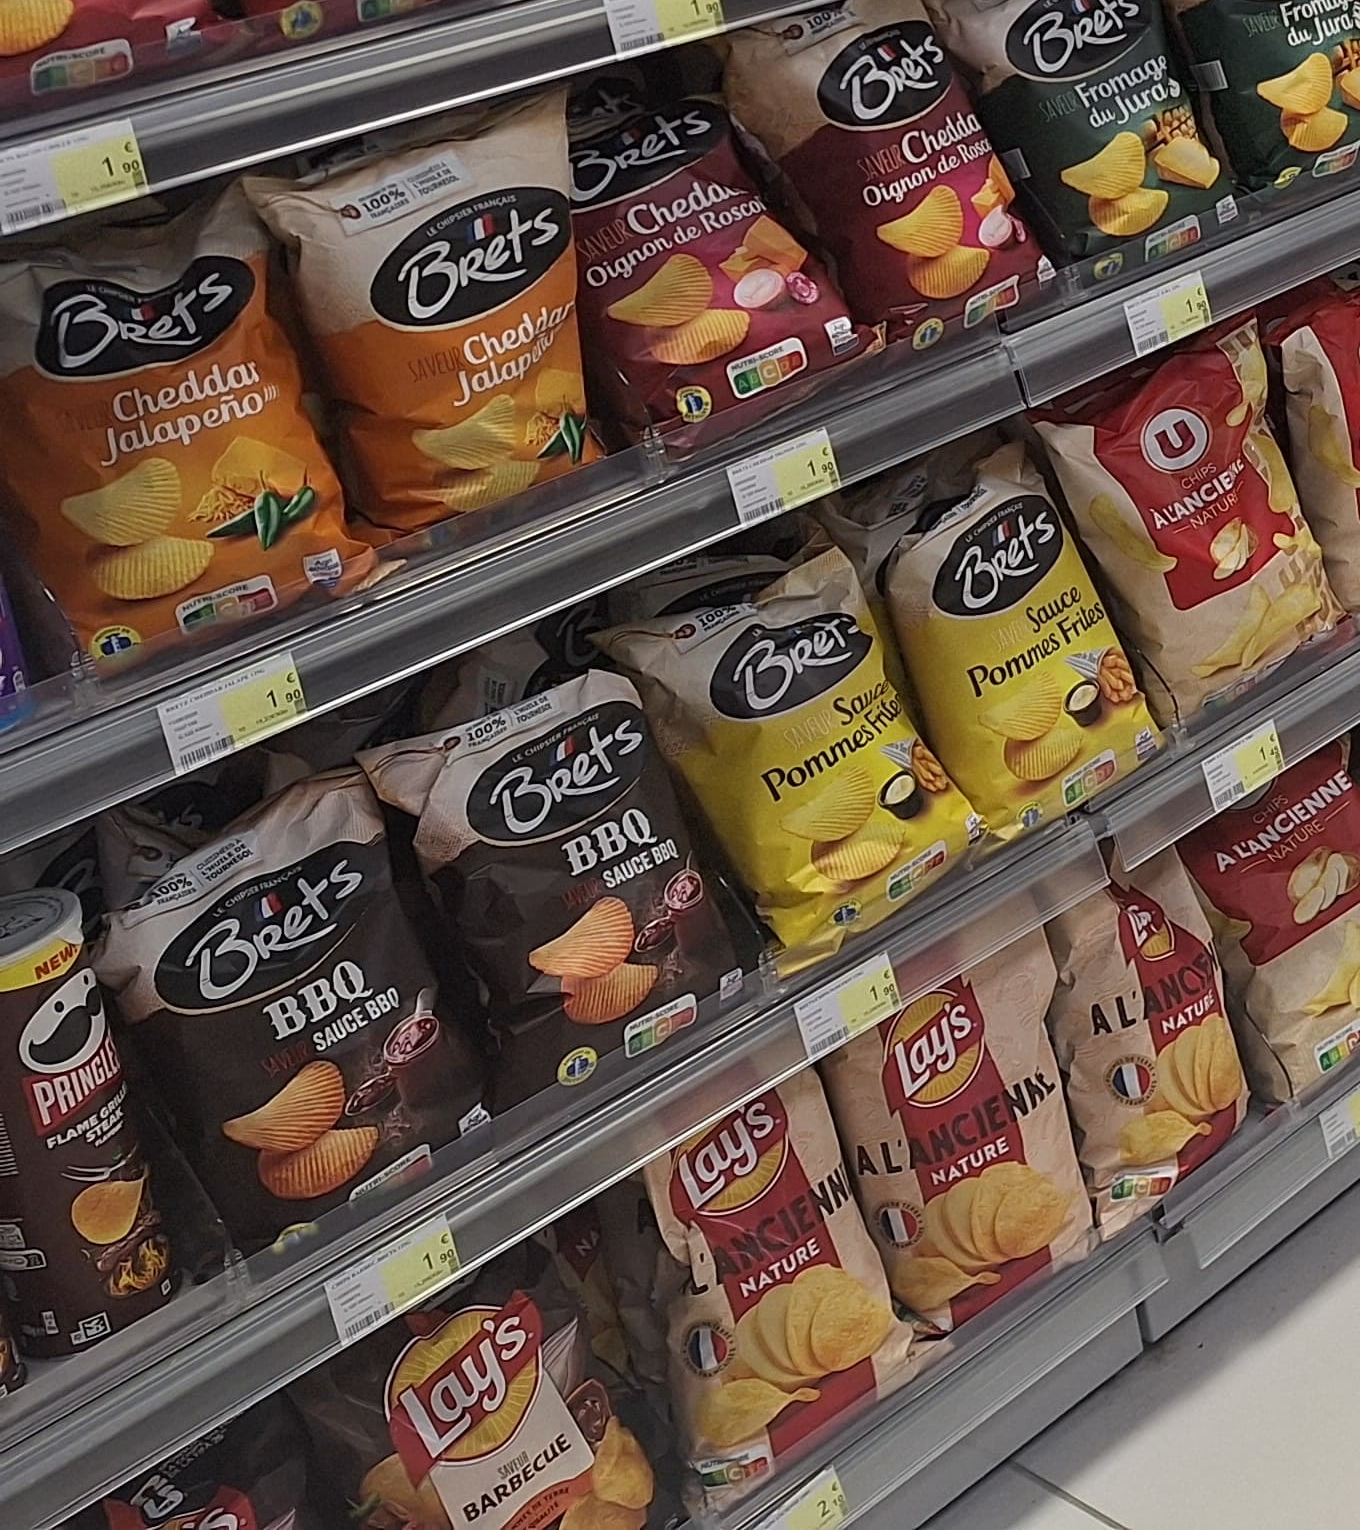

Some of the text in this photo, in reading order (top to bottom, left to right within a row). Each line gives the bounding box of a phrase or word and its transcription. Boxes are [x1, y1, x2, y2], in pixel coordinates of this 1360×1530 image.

[804, 8, 845, 31] 100%
[1243, 12, 1280, 37] SAVEUR
[1287, 11, 1353, 46] du Jura
[840, 32, 945, 122] Brets
[1039, 53, 1169, 123] SAVEUR Fromage
[1088, 87, 1165, 128] du Jura
[102, 156, 114, 177] 1
[122, 159, 140, 173] 90
[361, 187, 406, 213] 100%
[426, 194, 517, 237] LE CHIPSIER FRANÇAIS
[401, 200, 560, 320] Brets
[586, 197, 768, 289] Oignon de Rosco
[51, 270, 234, 369] Brets
[407, 299, 576, 384] SAVEUR Cheddar
[730, 344, 785, 372] NUTRI-SCORE
[111, 359, 261, 422] Cheddar
[100, 392, 265, 467] Jalapeño
[1180, 462, 1218, 491] CHIPS
[954, 505, 1055, 610] Brets
[966, 602, 1105, 699] Pommes Frites
[832, 676, 891, 726] Sauce
[466, 716, 507, 742] 100%
[511, 712, 599, 763] LE CHIPSIER FRANÇAIS
[489, 717, 645, 835] Brets
[1252, 794, 1290, 826] CHIPS
[201, 844, 247, 876] L'HUILE DE
[205, 849, 254, 882] TOURNESOL
[561, 806, 658, 877] BBQ
[602, 858, 652, 890] SAUCE
[651, 839, 680, 868] BBQ
[1266, 819, 1326, 866] NATURE
[212, 867, 302, 918] LE CHIPSIER FRANÇAIS
[185, 860, 364, 1001] Brets
[33, 943, 79, 981] NEW!
[262, 960, 374, 1041] BBQ
[311, 986, 400, 1051] SAUCE BBQ
[1161, 989, 1217, 1036] NATURE
[894, 1000, 973, 1101] Lay's
[32, 1035, 120, 1126] PRINGLE
[46, 1081, 127, 1149] FLAME GRILL
[86, 1106, 124, 1142] STEAK
[676, 1100, 780, 1211] Lay's
[855, 1143, 884, 1176] A
[929, 1136, 1010, 1188] NATURE
[738, 1236, 822, 1300] NATURE
[399, 1314, 529, 1461] Lay's
[462, 1433, 572, 1524] BARBECUE
